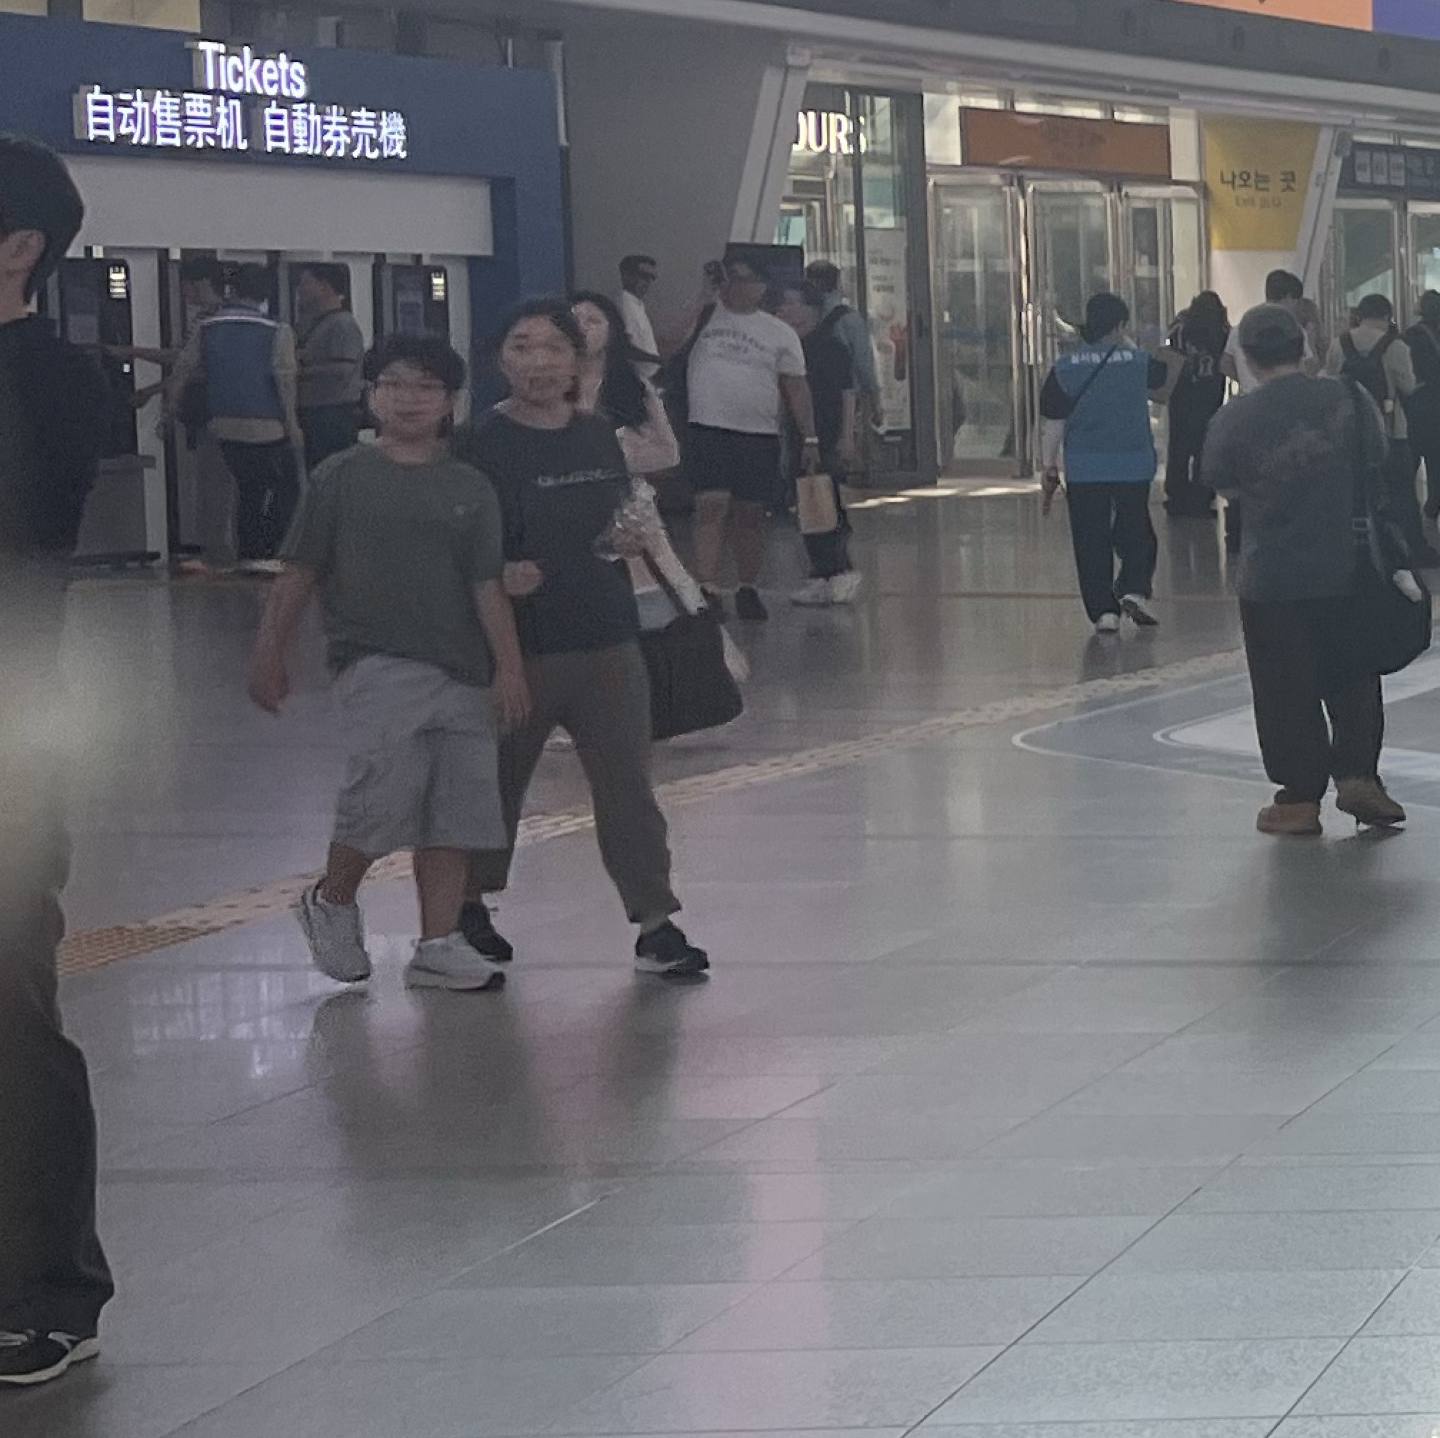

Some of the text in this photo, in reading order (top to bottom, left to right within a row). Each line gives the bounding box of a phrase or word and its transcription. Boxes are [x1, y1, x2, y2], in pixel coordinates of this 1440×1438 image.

[198, 41, 308, 98] Tickets
[85, 84, 408, 160] 自动售票机 自動券売機
[1219, 169, 1296, 192] 나오는 곳
